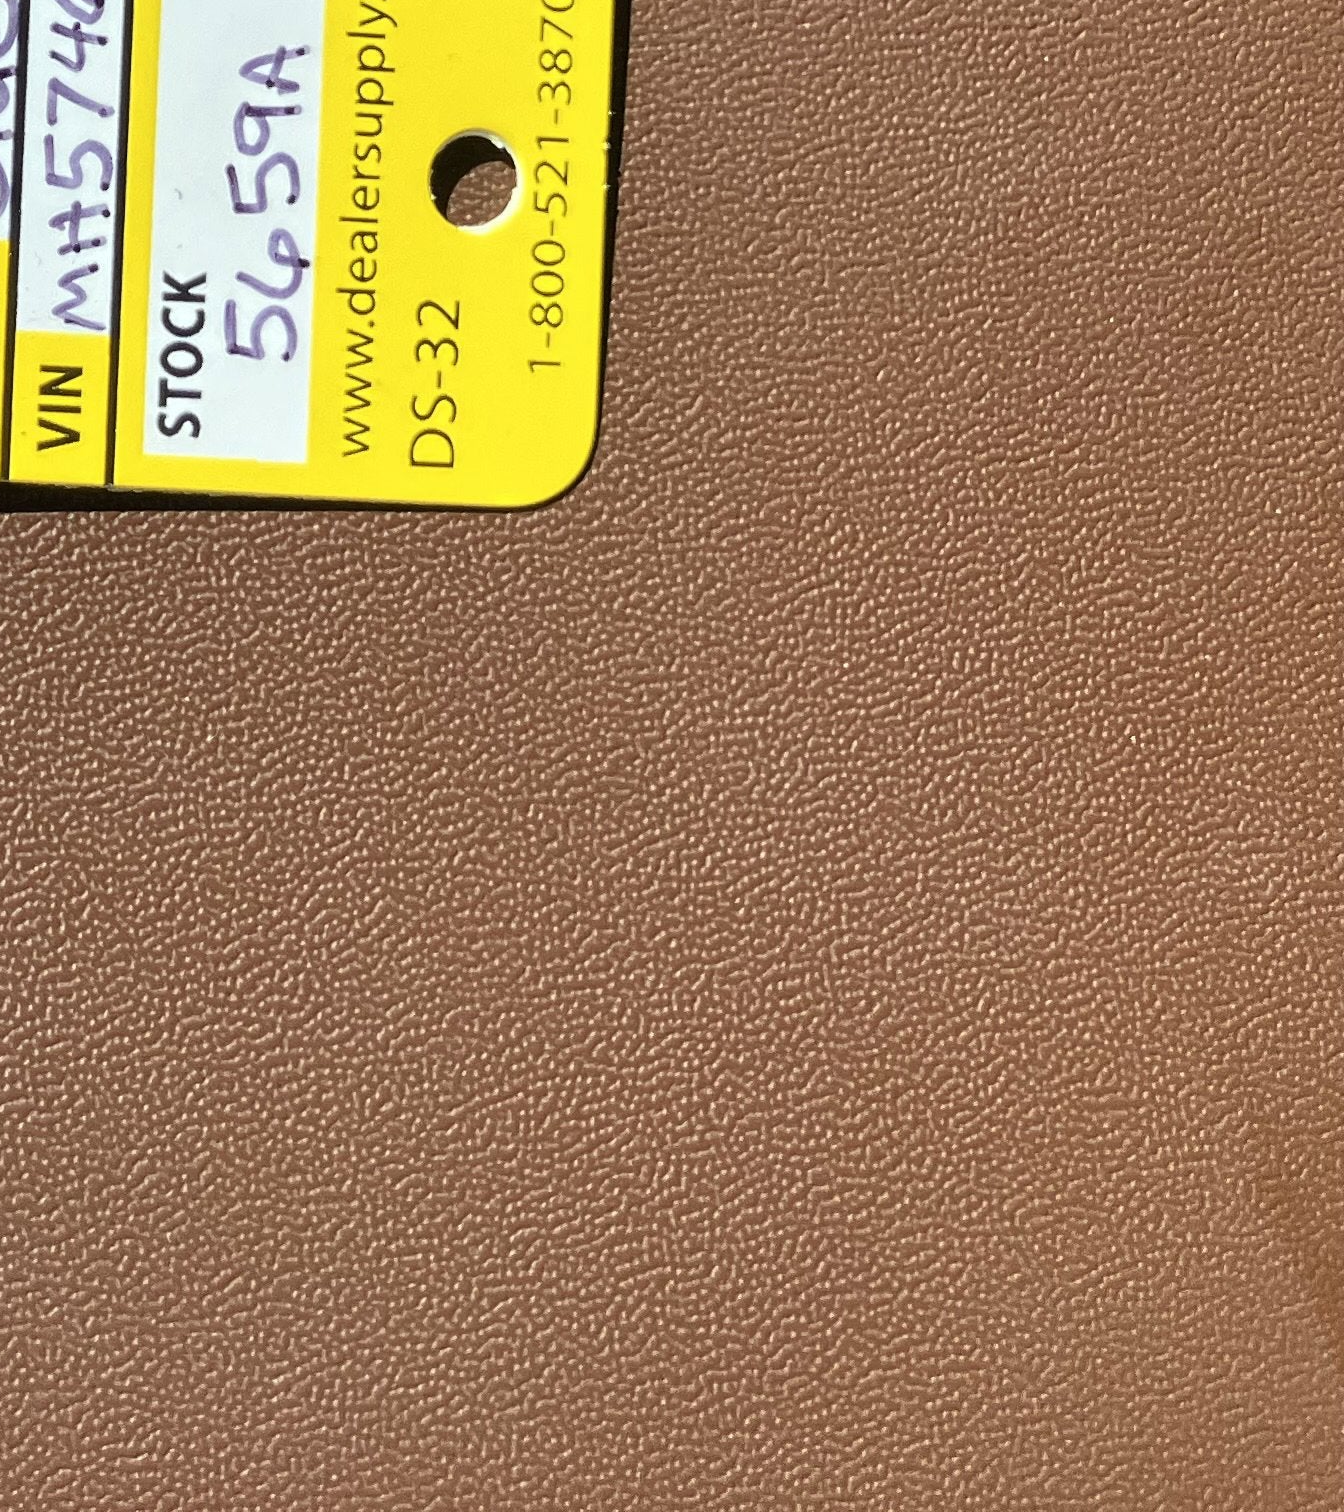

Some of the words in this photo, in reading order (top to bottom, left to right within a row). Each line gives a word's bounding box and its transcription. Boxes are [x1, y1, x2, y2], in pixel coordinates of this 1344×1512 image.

[225, 45, 311, 361] 5659A
[37, 362, 83, 451] VIN
[158, 271, 207, 438] STOCK
[409, 298, 461, 470] DS-32
